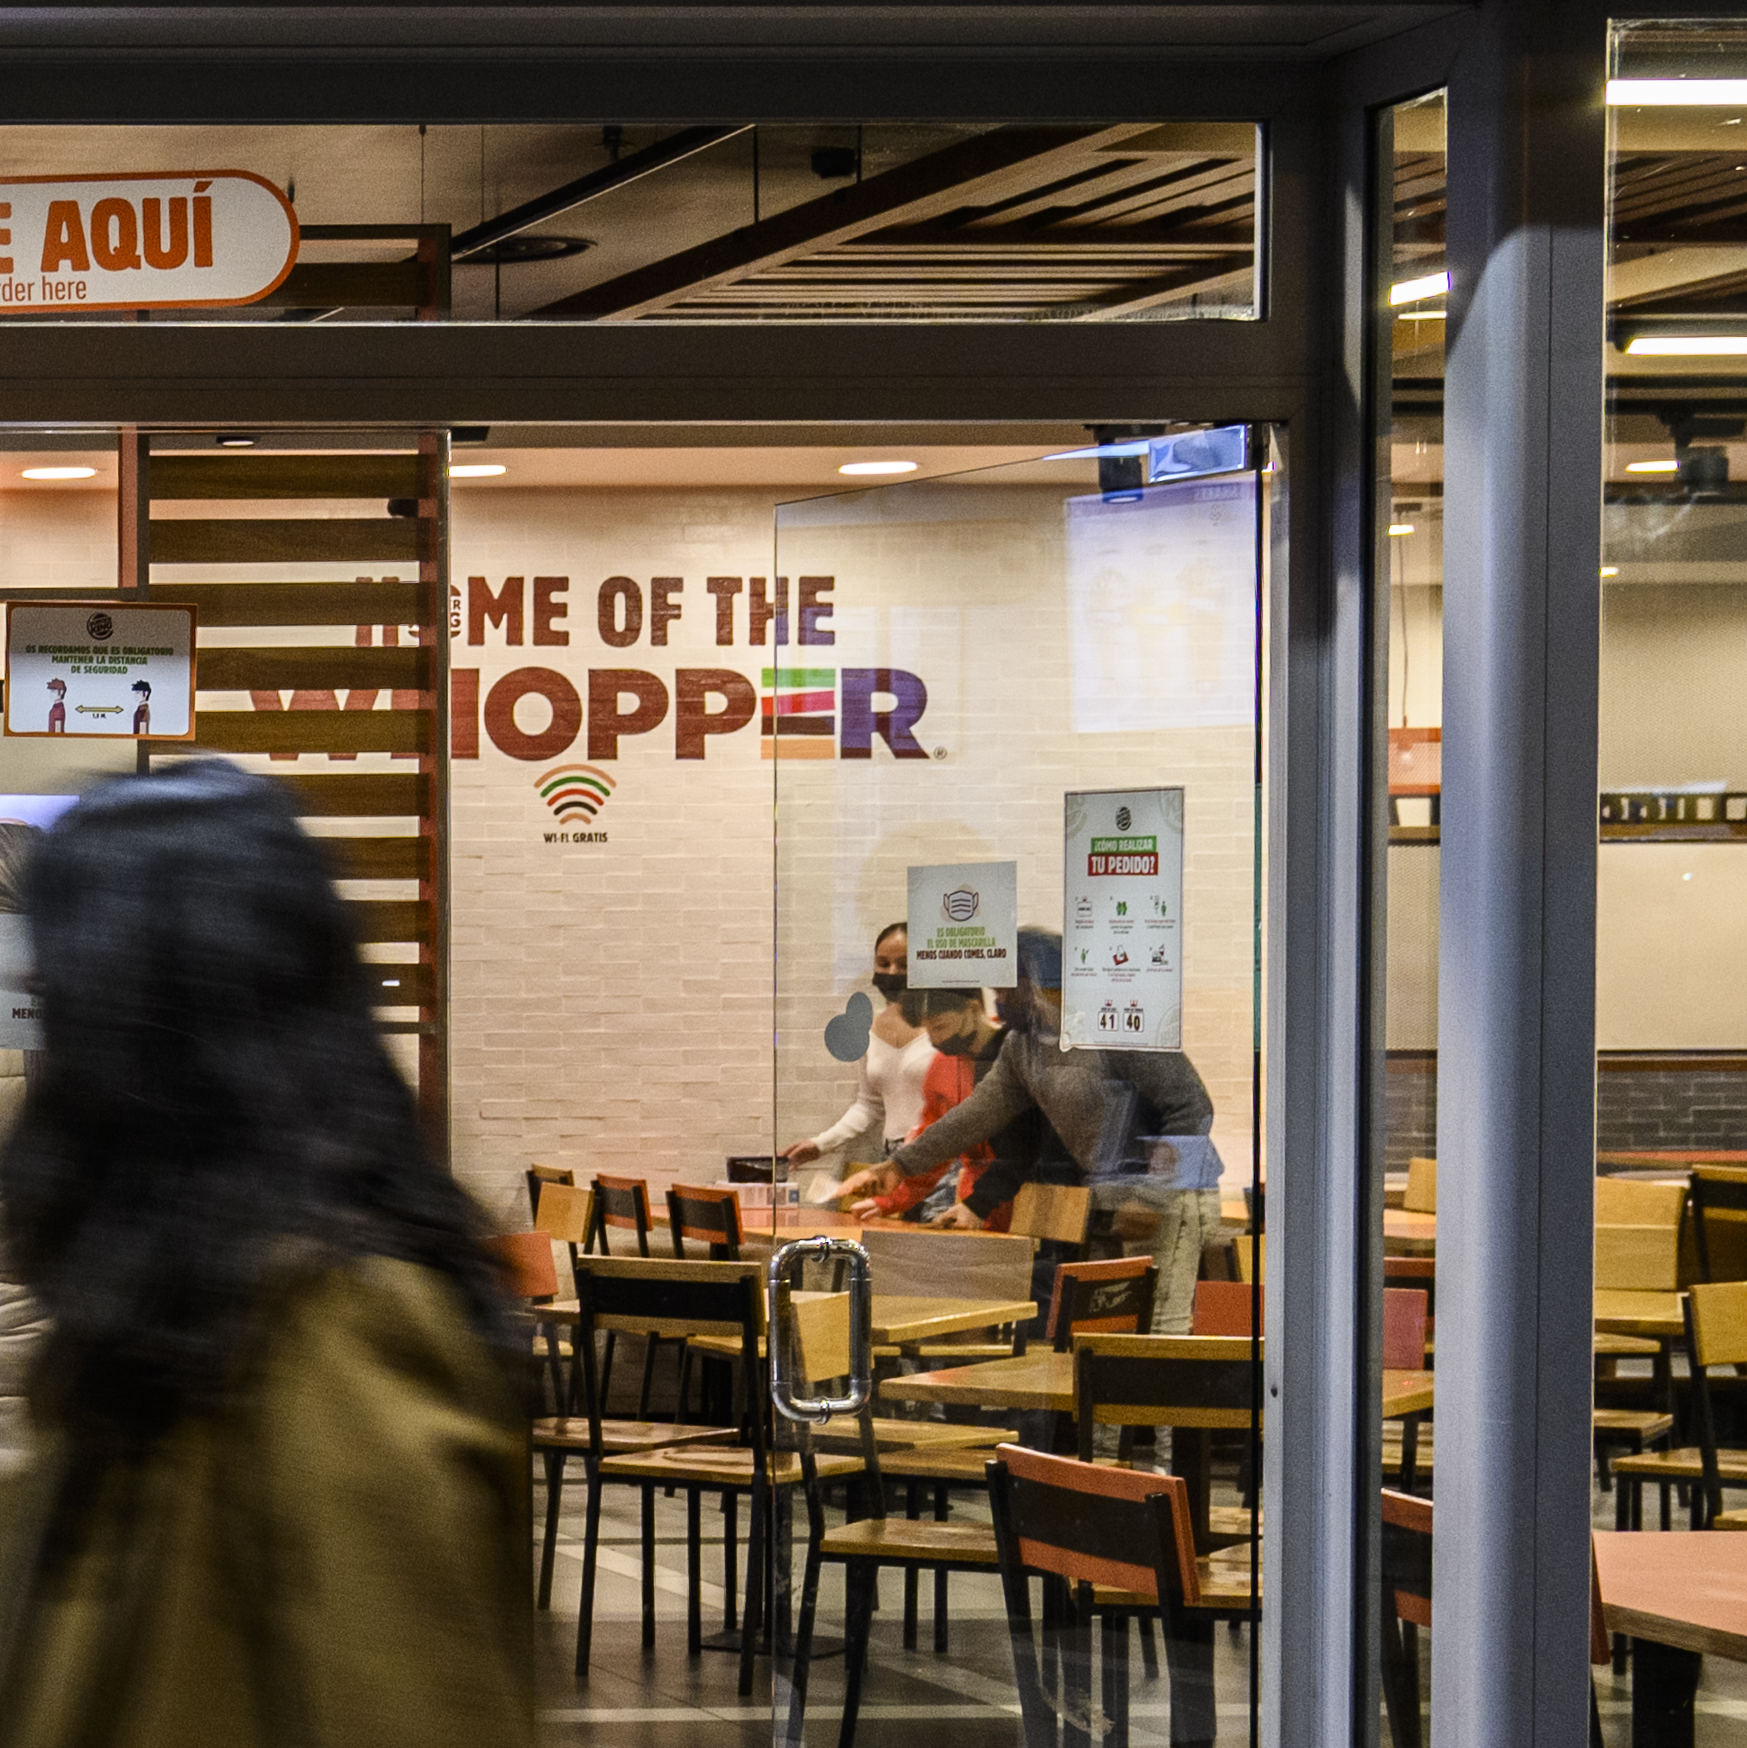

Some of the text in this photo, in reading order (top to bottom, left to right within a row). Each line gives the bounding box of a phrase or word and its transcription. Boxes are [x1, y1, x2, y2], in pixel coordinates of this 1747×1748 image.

[41, 180, 214, 272] AQUÍ
[43, 275, 87, 301] here
[597, 575, 684, 649] OF
[707, 575, 836, 647] THE
[38, 645, 91, 654] RECORDAMOS
[93, 646, 109, 655] QUE
[110, 646, 121, 655] ES
[122, 646, 174, 656] OBLIGATORIO
[51, 655, 148, 665] MANTENER LA DISTANCIA
[70, 665, 128, 674] DE SEGURIDAD
[544, 832, 608, 843] WI-FI GRATIS
[1119, 838, 1153, 851] REALIZAR
[1091, 855, 1156, 874] TU PEDIDO?
[937, 926, 985, 938] ES OBLIGATORIO
[927, 937, 996, 949] EL USO DE MASCARILLA
[916, 948, 1007, 960] MENOS CUANDO COMES, CLARO
[12, 1007, 42, 1019] MENO
